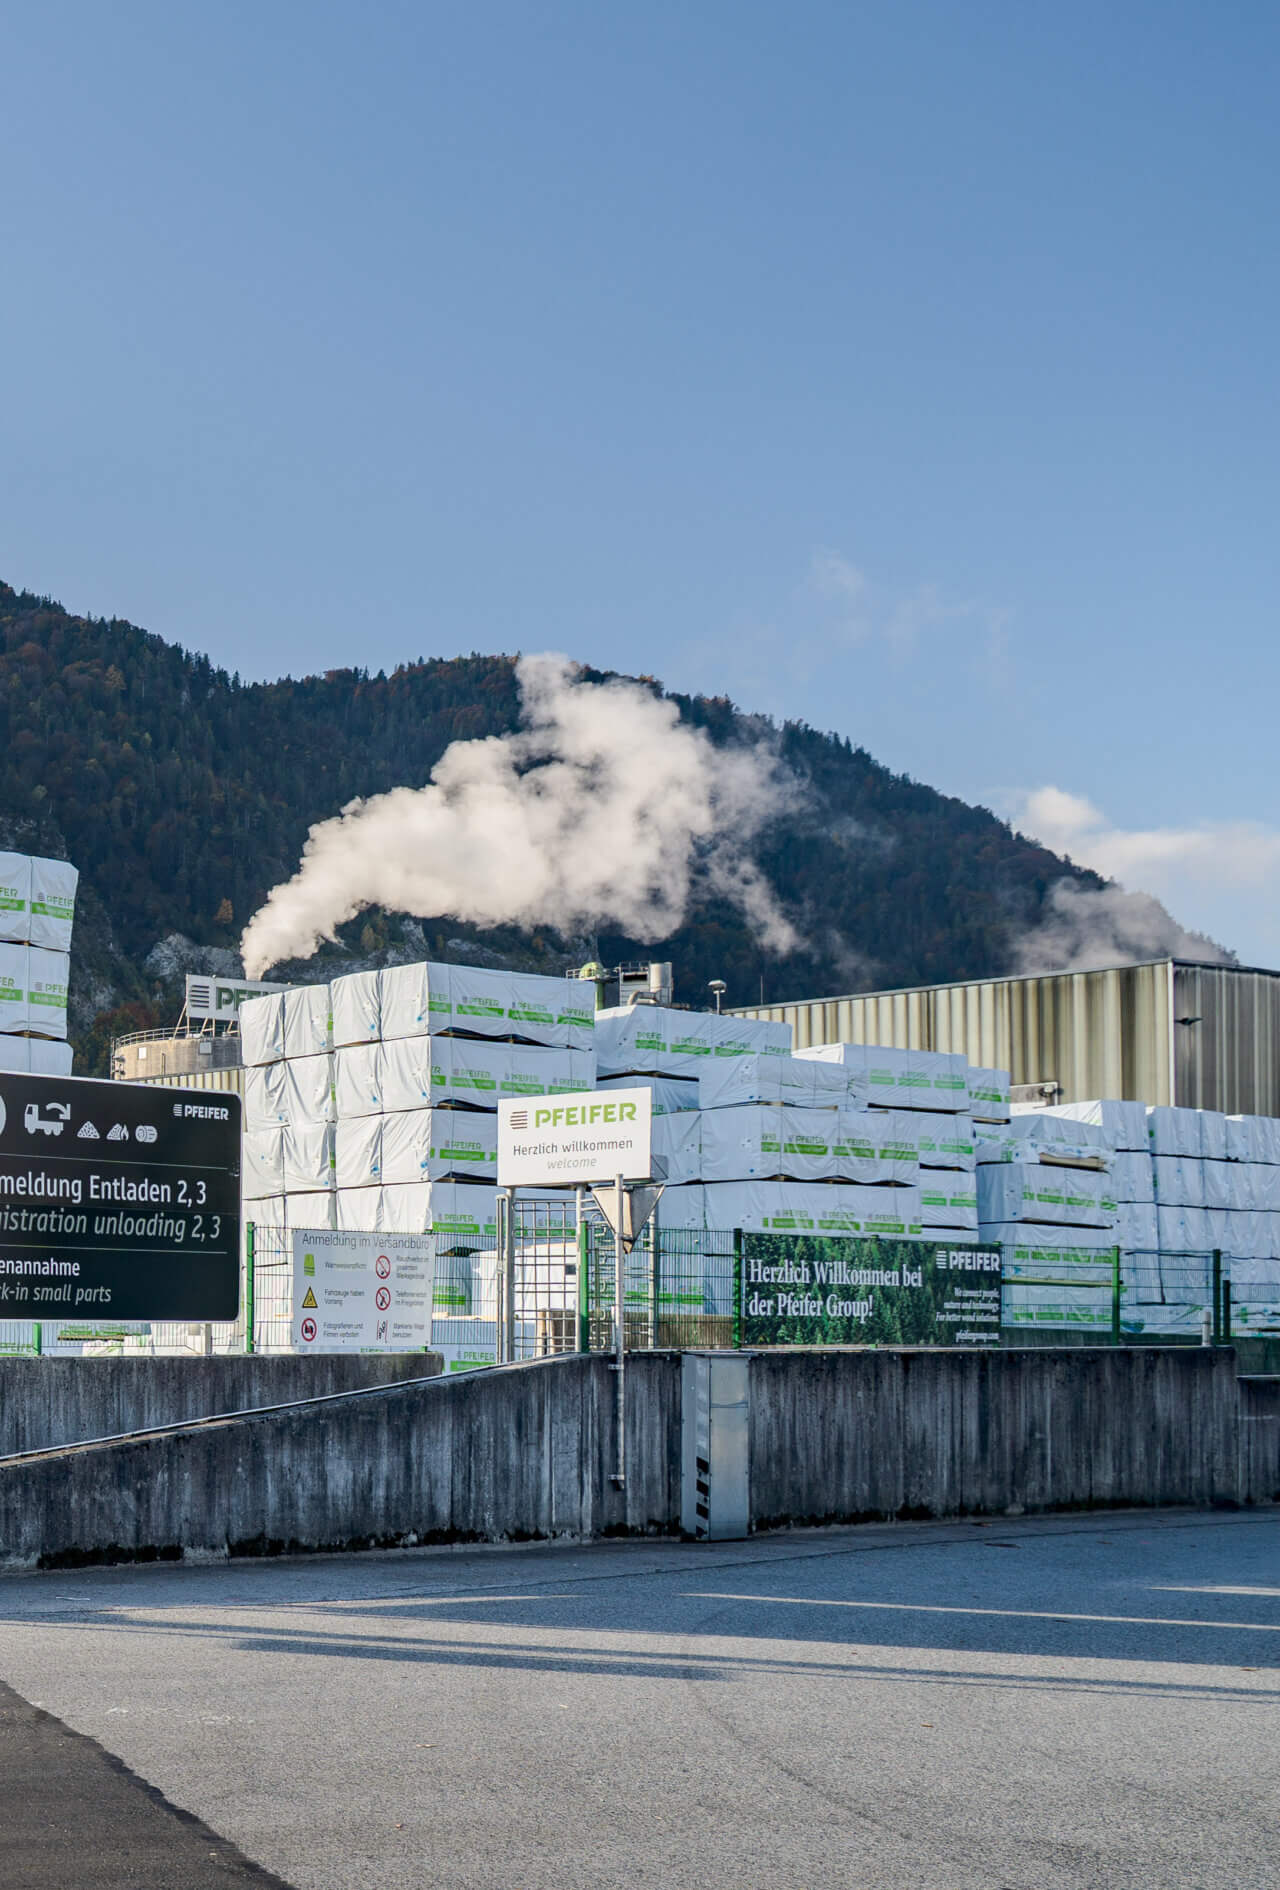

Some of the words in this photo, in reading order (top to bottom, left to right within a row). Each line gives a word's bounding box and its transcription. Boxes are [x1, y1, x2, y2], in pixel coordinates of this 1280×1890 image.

[184, 1104, 229, 1120] PFEIFER
[535, 1102, 637, 1128] PFEIFER
[513, 1143, 558, 1156] Herzlich
[562, 1138, 633, 1153] willkommen
[547, 1157, 597, 1169] welcome
[89, 1175, 171, 1203] Entladen
[94, 1212, 186, 1242] unloading
[302, 1233, 357, 1249] Anmeldung
[359, 1236, 371, 1247] im
[373, 1236, 429, 1250] Versandbüro
[949, 1251, 1000, 1271] PFEIFER
[750, 1259, 810, 1284] Herzlich
[813, 1260, 899, 1286] Willkommen
[902, 1264, 923, 1287] bei
[33, 1284, 71, 1302] small
[75, 1285, 112, 1305] parts
[749, 1292, 771, 1316] der
[777, 1293, 823, 1317] Pfeifer
[826, 1294, 873, 1323] Group!
